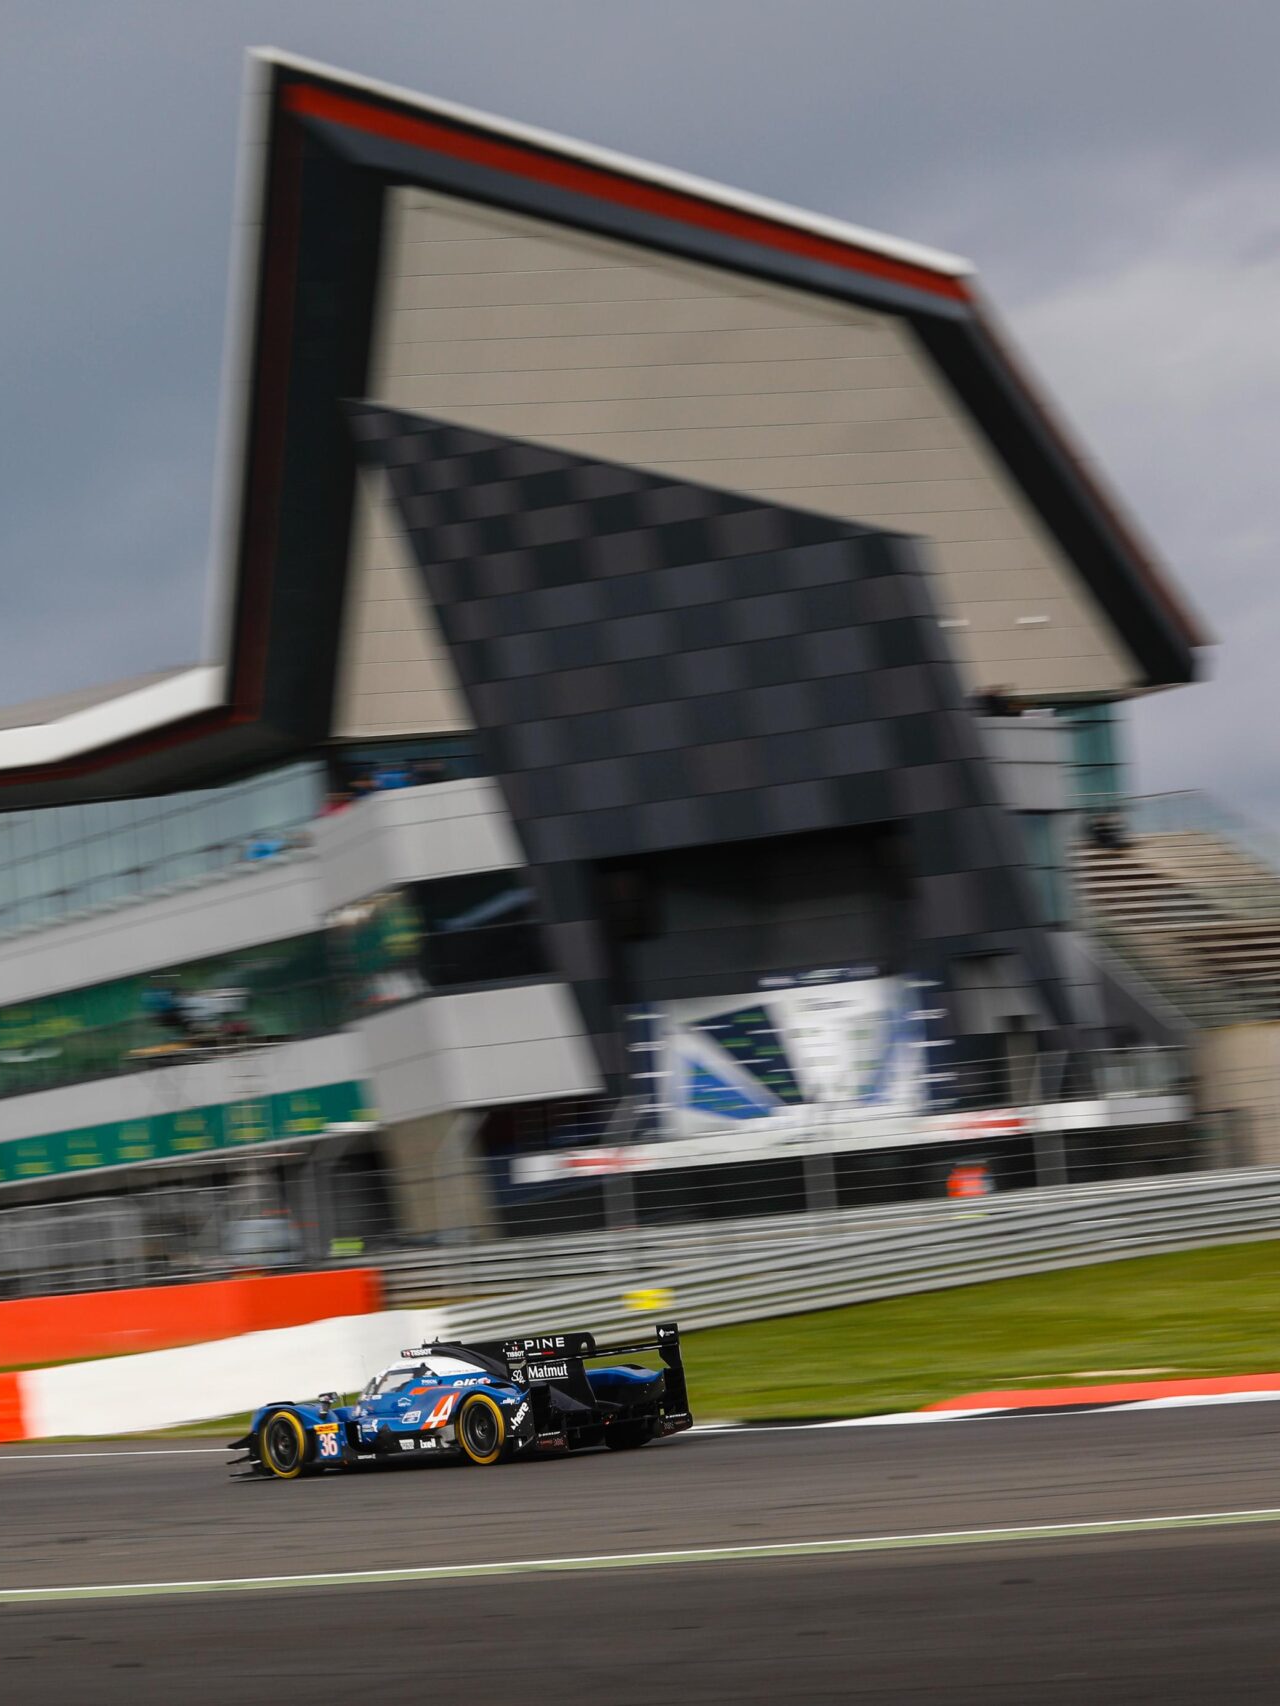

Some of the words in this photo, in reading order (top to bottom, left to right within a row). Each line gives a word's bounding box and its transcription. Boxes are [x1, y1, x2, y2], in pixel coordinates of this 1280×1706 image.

[411, 1348, 432, 1357] TISSOT
[528, 1362, 568, 1378] Matmut
[510, 1402, 529, 1427] here
[320, 1433, 338, 1456] 36
